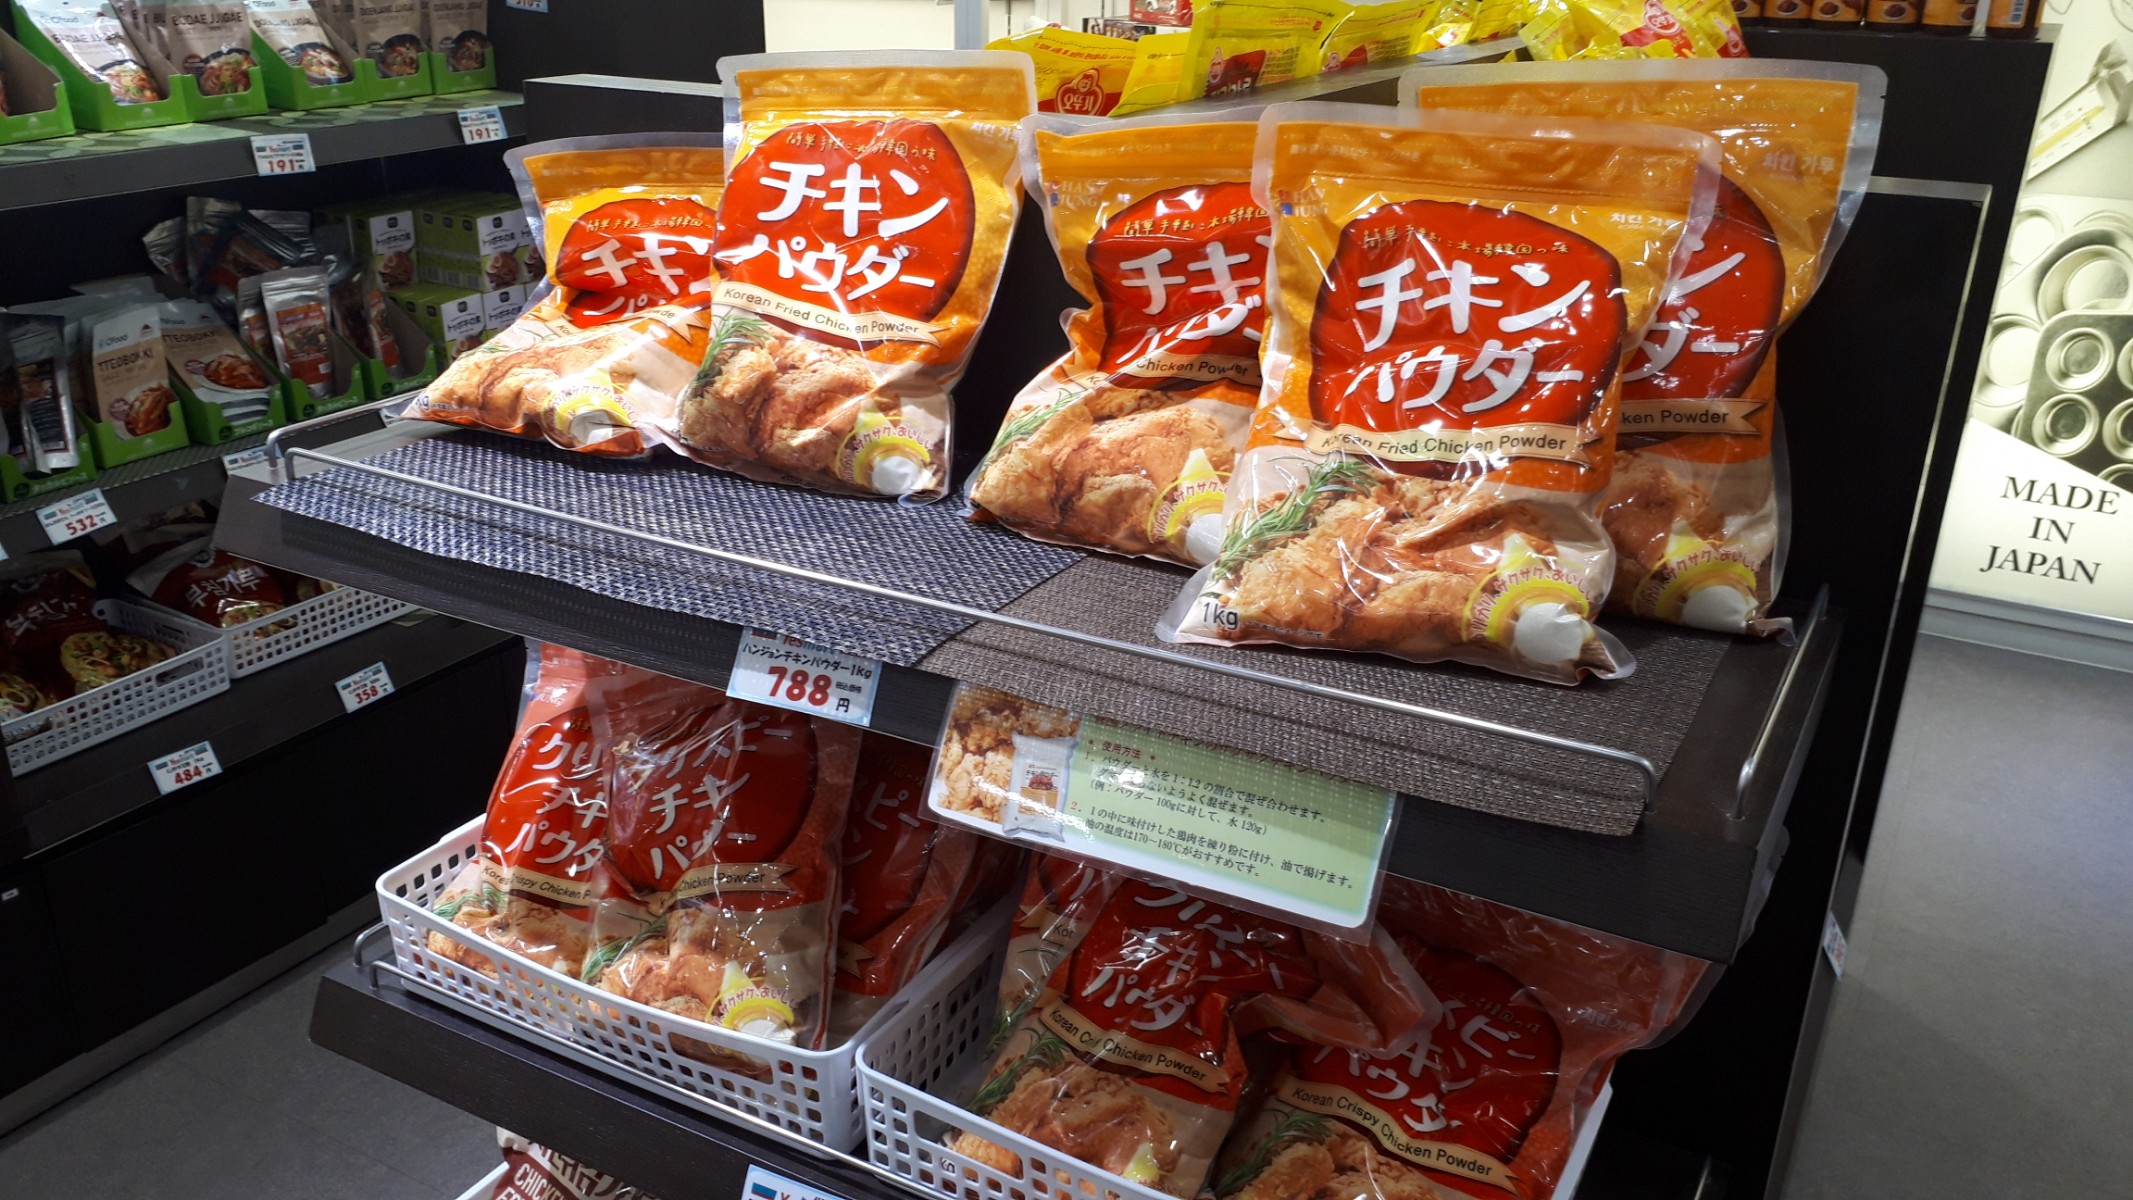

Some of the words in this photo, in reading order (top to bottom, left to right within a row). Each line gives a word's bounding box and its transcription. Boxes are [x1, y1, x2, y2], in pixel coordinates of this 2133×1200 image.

[1063, 93, 1095, 112] 오뚜기
[468, 127, 492, 142] 191
[267, 160, 295, 174] 191
[756, 159, 950, 239] チキン
[1609, 212, 1644, 226] 치킨
[724, 235, 937, 302] パウダー
[723, 287, 772, 306] Korean
[774, 303, 811, 321] Fried
[814, 313, 869, 334] Chicen
[871, 320, 919, 334] Powder
[1355, 257, 1592, 353] チキン
[1342, 337, 1585, 414] パウダー
[1660, 410, 1730, 425] Powder
[1320, 432, 1373, 448] Korean
[1376, 440, 1419, 456] Fried
[1425, 437, 1493, 455] Chicken
[1500, 435, 1567, 452] Powder
[2000, 475, 2121, 515] MADE
[65, 514, 98, 536] 532
[2028, 516, 2076, 544] IN
[1979, 545, 2102, 584] JAPAN
[1201, 601, 1239, 631] 1kg
[353, 685, 380, 705] 358
[767, 665, 832, 707] 788
[835, 697, 851, 713] 円
[1101, 740, 1142, 760] 使用方法
[174, 765, 205, 785] 484
[482, 865, 510, 886] Kore
[511, 872, 538, 889] rispy
[538, 881, 582, 900] Chicken
[1049, 1007, 1080, 1037] Korean
[1103, 1038, 1153, 1063] Chicken
[1156, 1053, 1208, 1081] Powder
[1292, 1086, 1333, 1107] Korean
[1336, 1095, 1380, 1127] Crispy
[1380, 1123, 1432, 1160] Chicken
[1435, 1148, 1493, 1176] Powder
